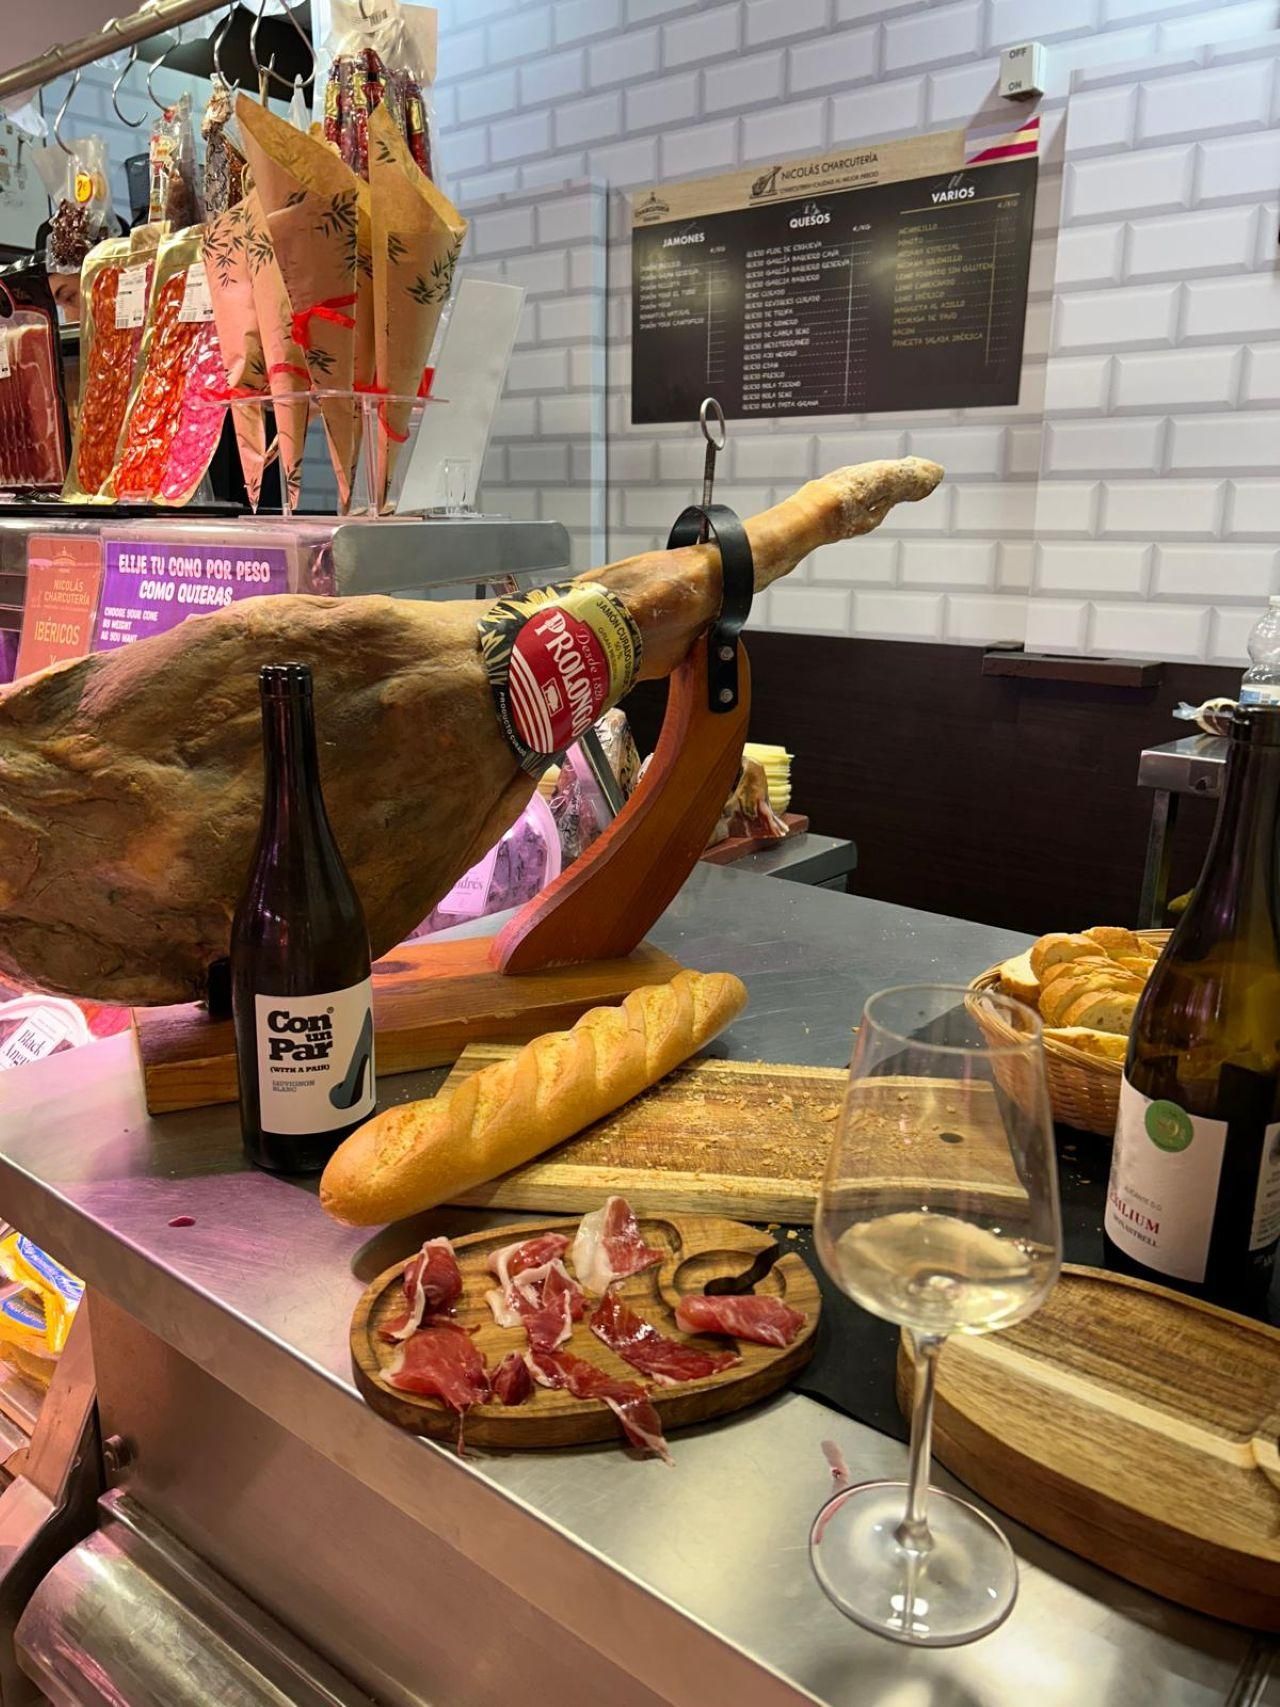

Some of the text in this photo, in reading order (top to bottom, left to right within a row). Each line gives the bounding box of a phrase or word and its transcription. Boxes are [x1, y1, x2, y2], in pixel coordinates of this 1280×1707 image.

[1009, 48, 1026, 58] OFF
[1008, 80, 1022, 91] ON
[781, 151, 878, 180] NICOLÁS CHARCUTERÍA
[931, 186, 975, 203] VARIOS
[789, 213, 831, 229] QUESOS
[662, 232, 705, 248] JAMONES
[746, 249, 765, 258] QUESO
[746, 260, 764, 268] QUESO
[962, 263, 994, 273] GLUTEN
[745, 270, 764, 279] QUESO
[745, 281, 764, 289] QUESO
[744, 301, 763, 309] QUESO
[744, 312, 762, 320] QUESO
[744, 322, 762, 330] QUESO
[744, 332, 762, 340] QUESO
[743, 342, 762, 351] QUESO
[743, 353, 761, 361] QUESO
[743, 363, 761, 371] QUESO
[743, 373, 761, 381] QUESO
[742, 383, 760, 391] QUESO
[742, 393, 760, 401] QUESO
[742, 403, 760, 411] QUESO
[119, 553, 271, 583] ELIJE TU CONO POR PESO
[53, 577, 84, 592] NICOLÁS
[44, 591, 90, 605] CHARCUTERÍA
[139, 580, 233, 607] COMO QUIERAS
[104, 606, 159, 622] CHOOSE YOUR CONE
[102, 618, 132, 630] BY WEIGHT
[34, 616, 81, 645] IBÉRICOS
[597, 601, 621, 629] JAMÓN
[617, 627, 632, 661] CURADO
[100, 630, 138, 644] AS YOU WANT
[575, 628, 601, 673] Desde
[534, 611, 596, 737] PROLONGO
[500, 691, 513, 735] PRODUCTO
[454, 876, 483, 891] ndrés
[267, 1010, 333, 1033] Con
[17, 1029, 47, 1056] Black
[305, 1030, 333, 1043] un
[268, 1037, 333, 1061] Par
[270, 1066, 296, 1074] (WITH
[306, 1064, 330, 1073] PAIR)
